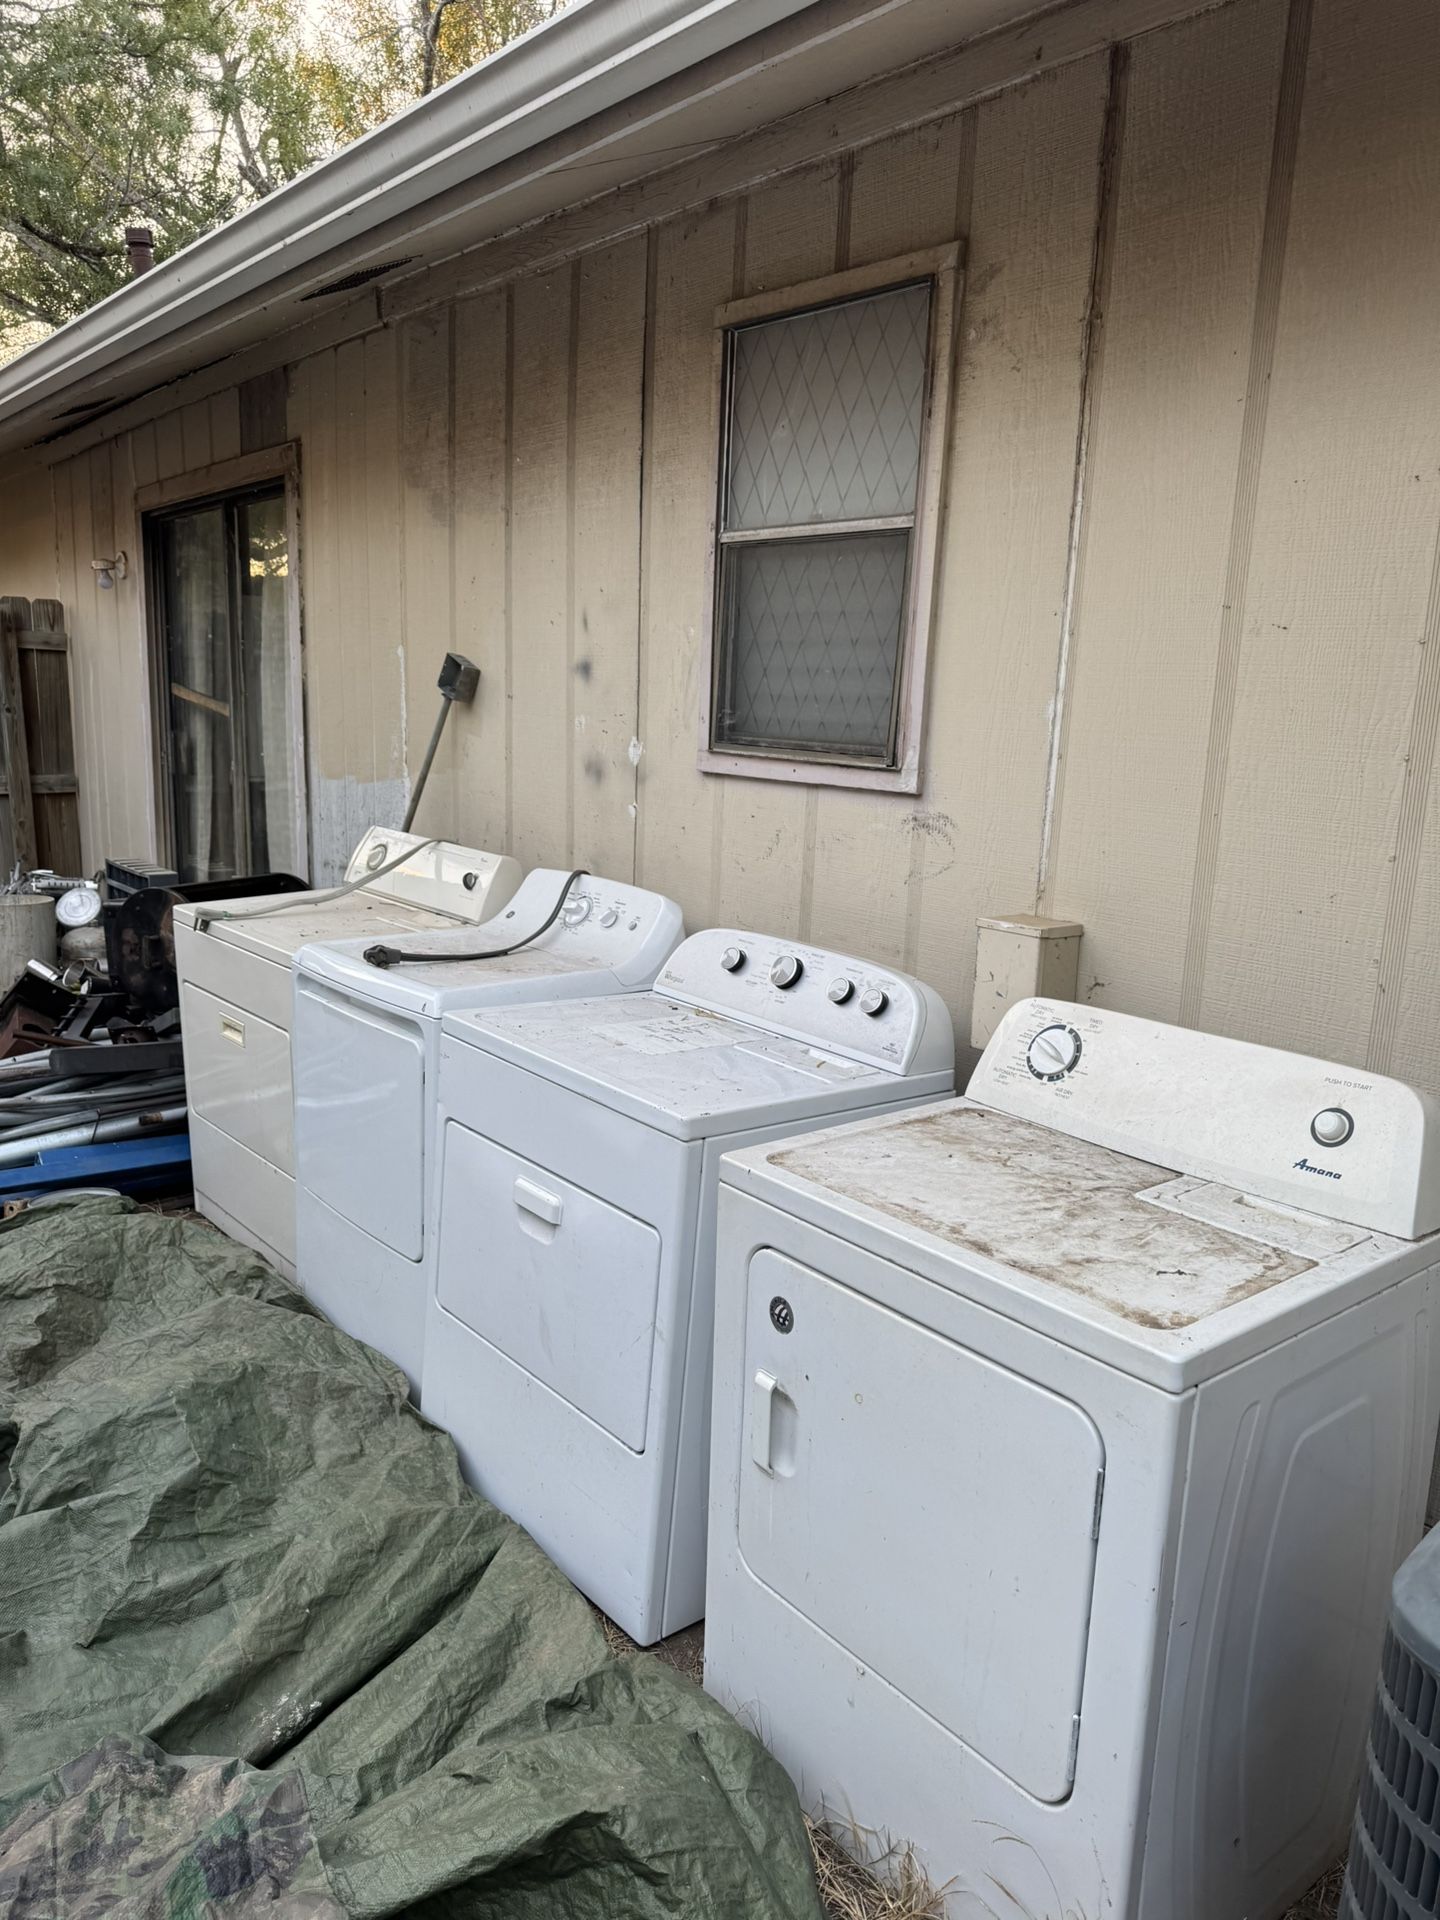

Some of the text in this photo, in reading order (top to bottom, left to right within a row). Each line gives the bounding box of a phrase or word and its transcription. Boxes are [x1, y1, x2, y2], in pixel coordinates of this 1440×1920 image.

[1324, 1077, 1342, 1085] PUSH
[1352, 1082, 1373, 1091] START
[1292, 1158, 1343, 1180] Amana
